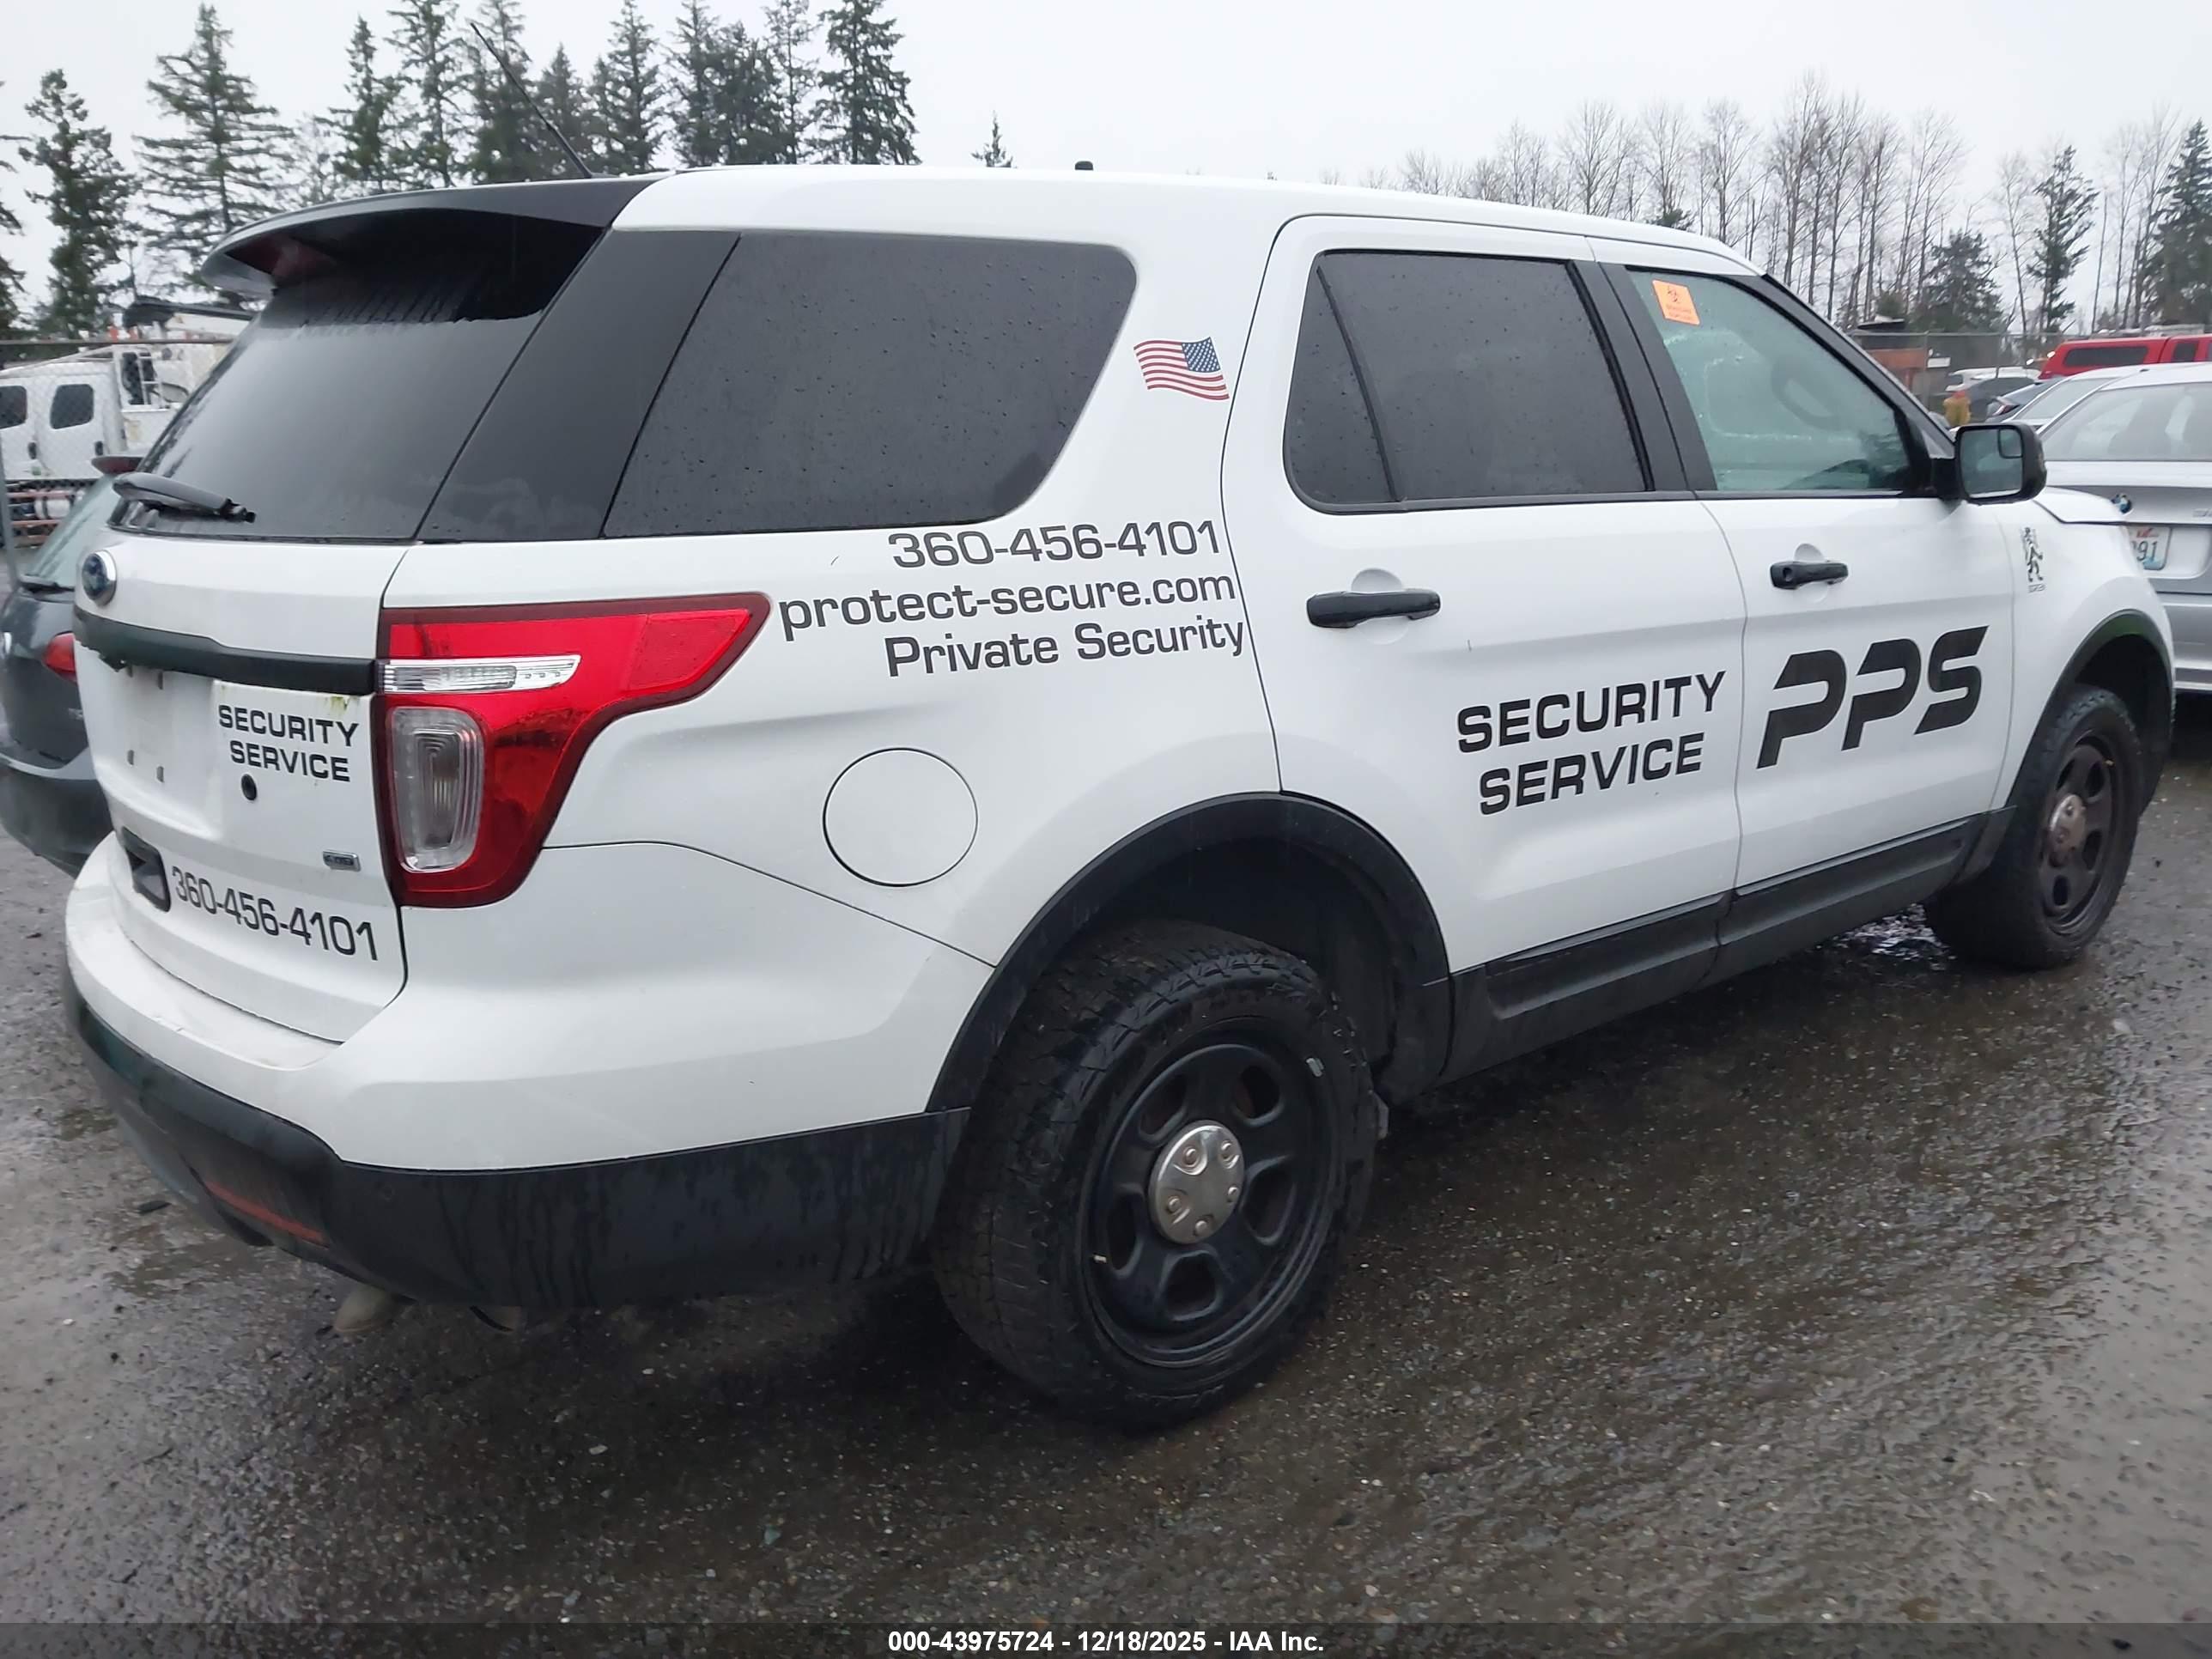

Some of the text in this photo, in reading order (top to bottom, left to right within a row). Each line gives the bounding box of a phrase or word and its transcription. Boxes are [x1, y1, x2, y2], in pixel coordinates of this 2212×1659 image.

[888, 520, 1219, 568] 360-456-4101
[779, 574, 1236, 641] protect-secure.com
[884, 614, 1244, 678] Private Security
[218, 704, 360, 747] SECURITY
[1457, 670, 1726, 753] SECURITY
[1756, 625, 1990, 769] PPS
[229, 739, 351, 782] SERVICE
[1479, 732, 1705, 816] SERVICE
[172, 866, 378, 961] 360-456-4101
